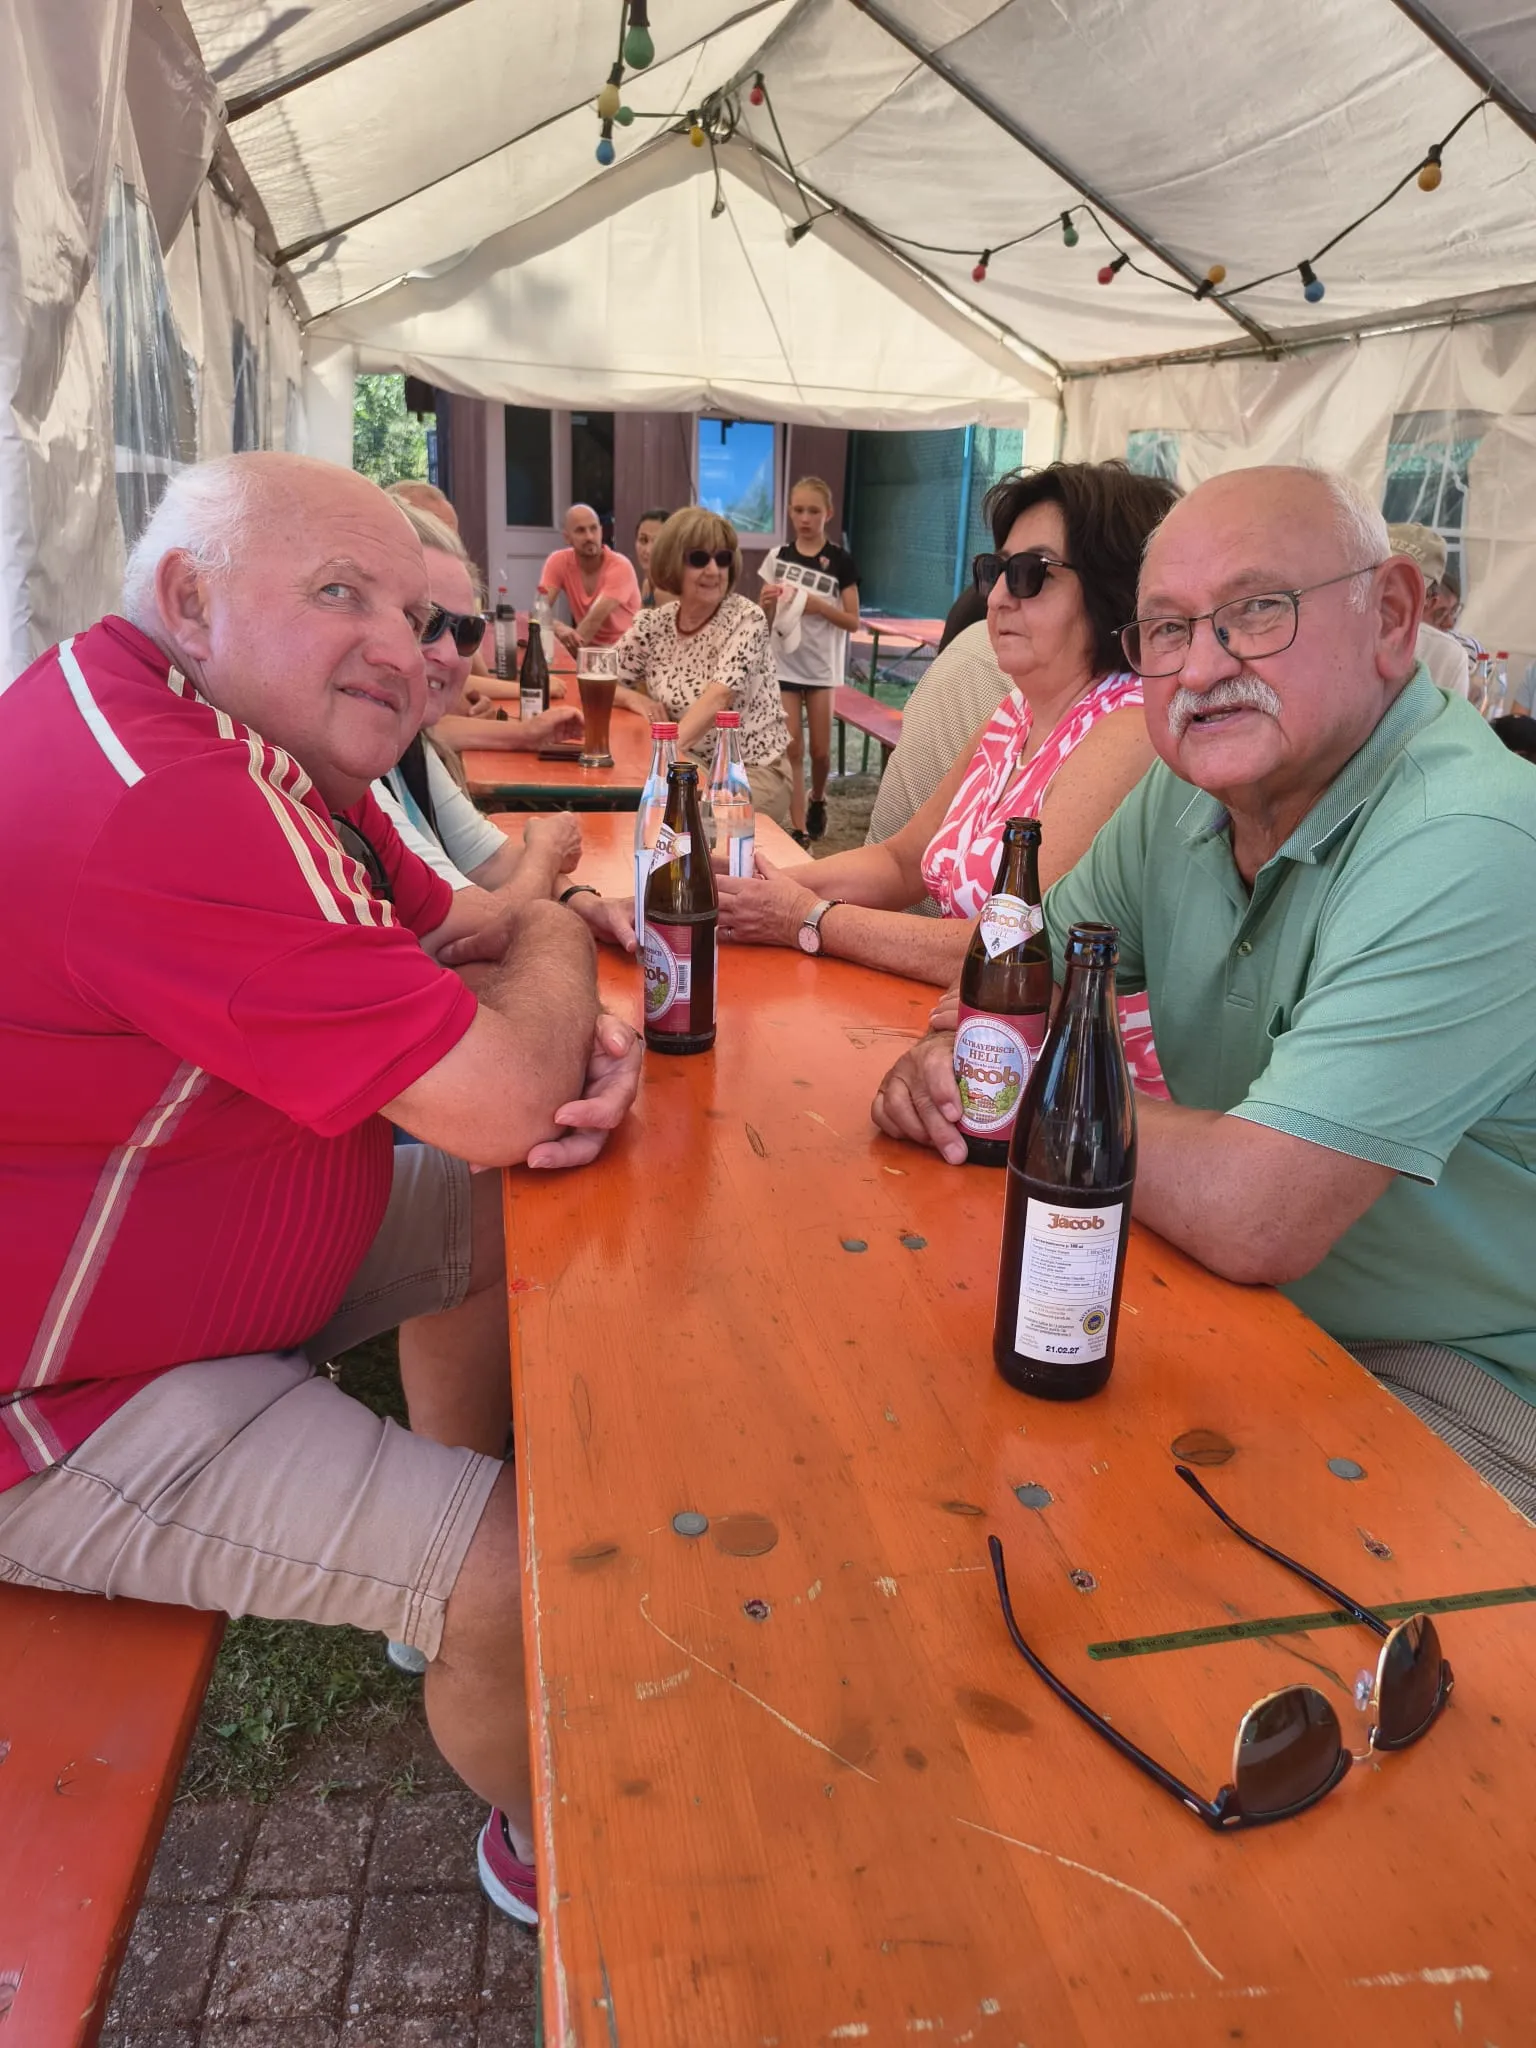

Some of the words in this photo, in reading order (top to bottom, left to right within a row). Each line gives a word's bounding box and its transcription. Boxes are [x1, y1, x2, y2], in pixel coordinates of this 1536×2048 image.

[982, 907, 1032, 932] Jacob
[962, 1038, 1015, 1053] ALTBAYERISCH
[969, 1049, 1002, 1064] HELL
[955, 1055, 1021, 1086] Jacob
[1048, 1213, 1105, 1230] Jacob
[1045, 1345, 1080, 1354] 21.02.27
